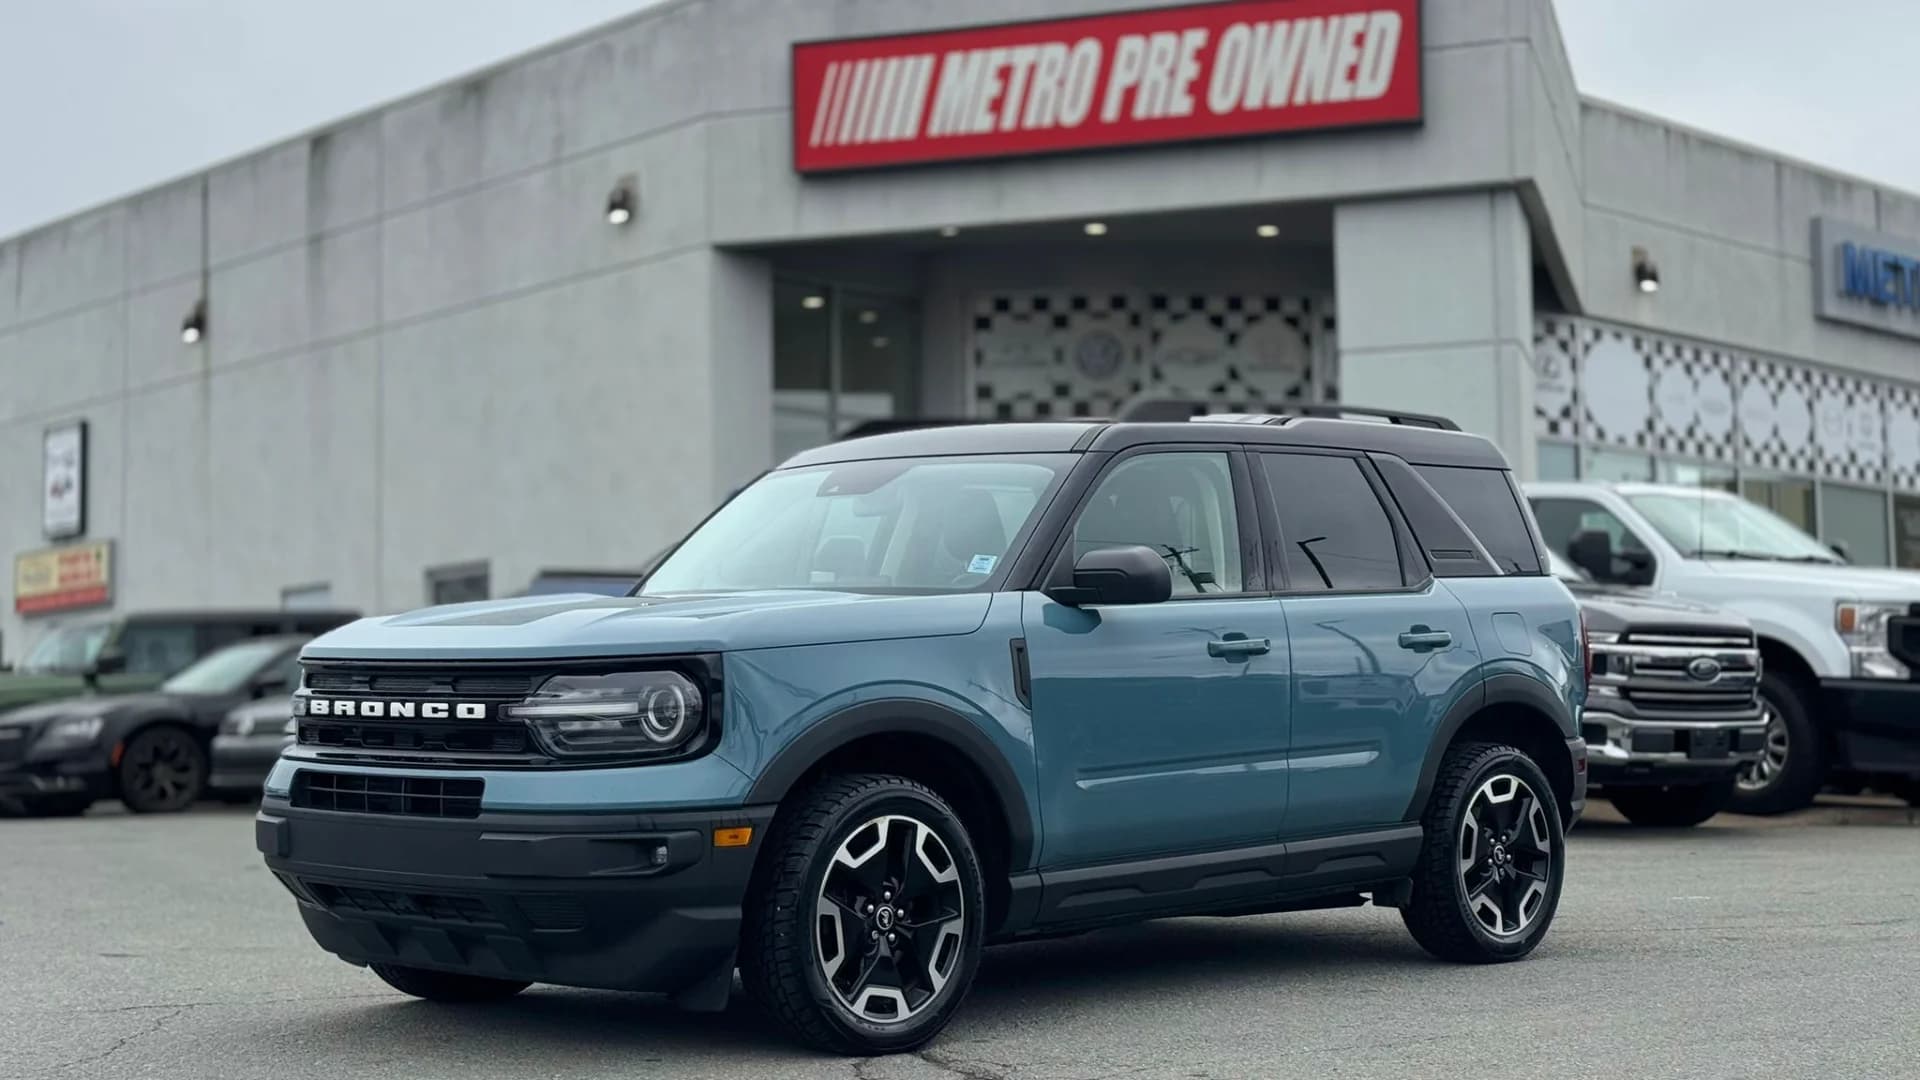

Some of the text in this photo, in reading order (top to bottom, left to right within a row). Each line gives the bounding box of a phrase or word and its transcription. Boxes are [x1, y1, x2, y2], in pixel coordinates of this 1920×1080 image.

[927, 11, 1401, 138] METRO PRE OWNED
[310, 699, 486, 719] BRONCO
